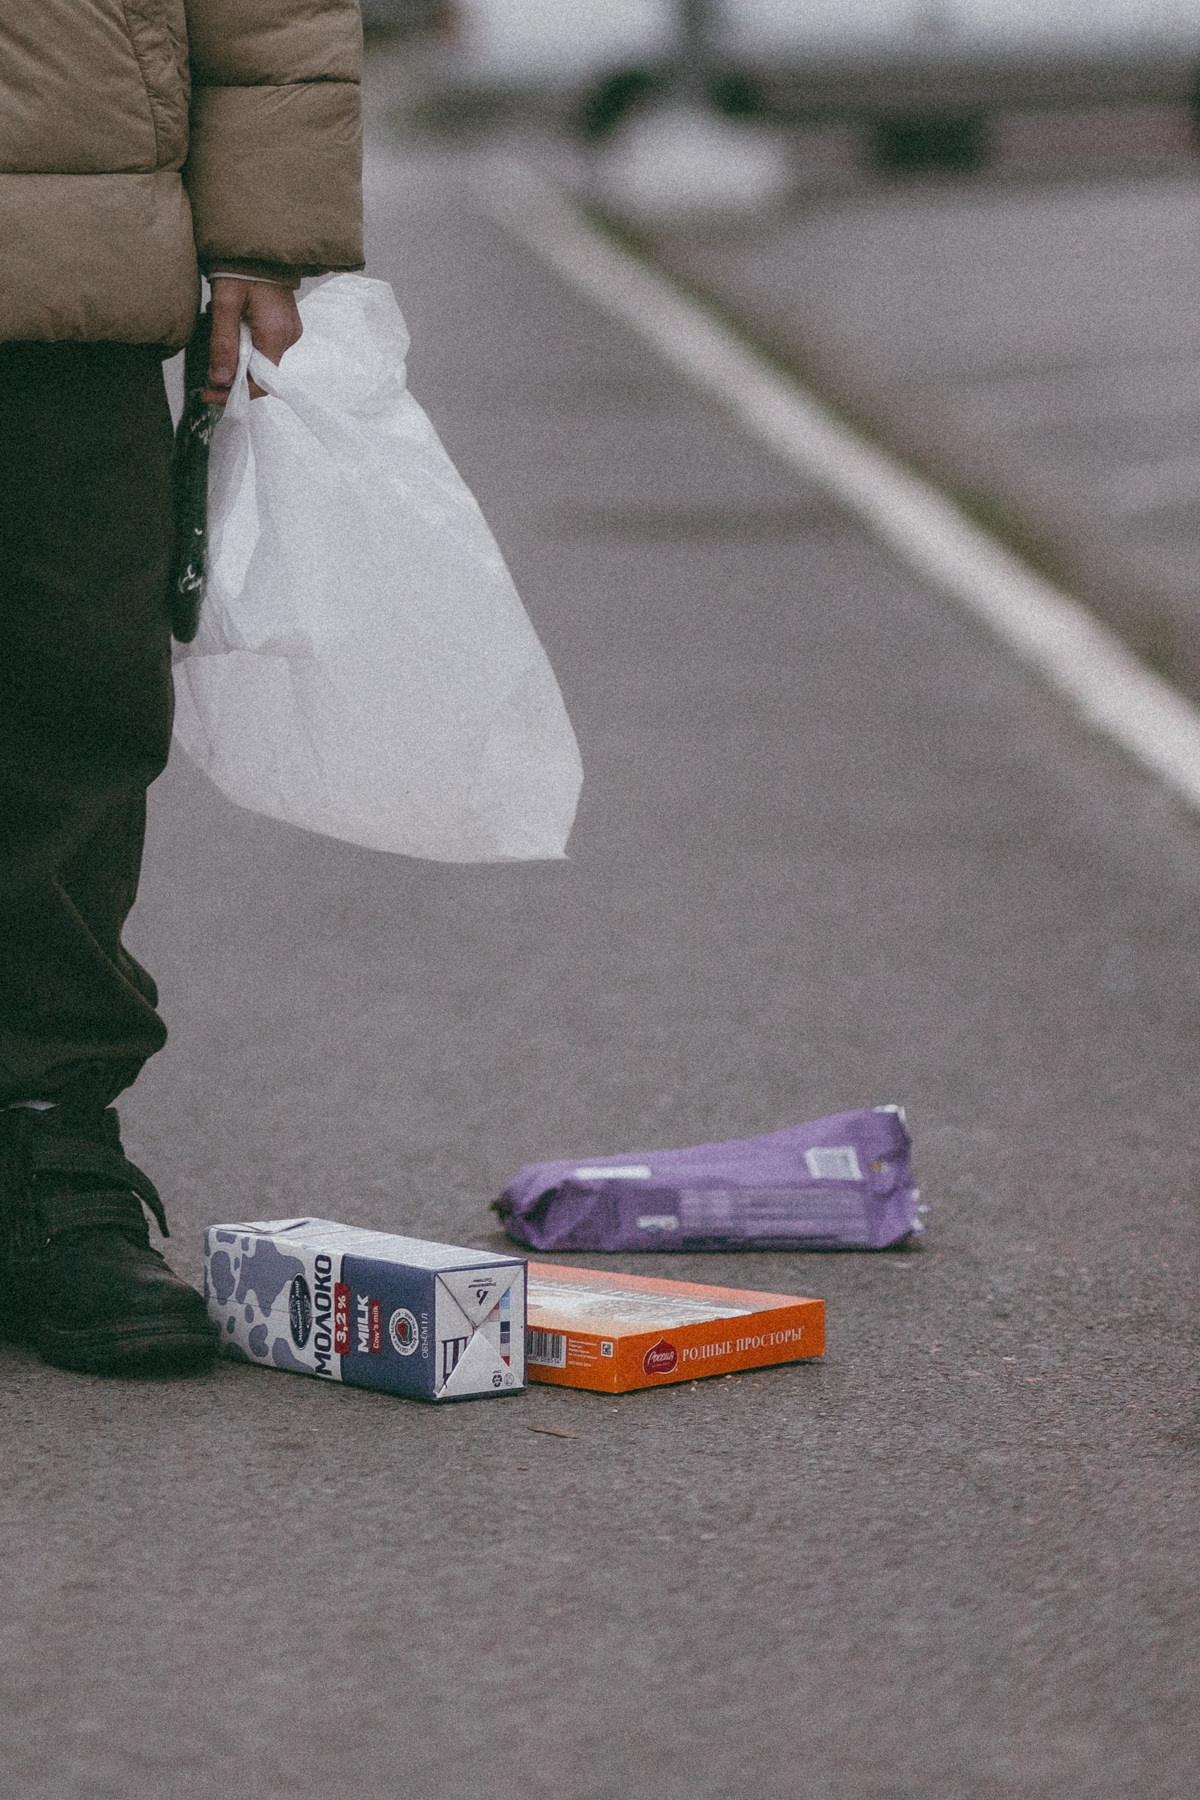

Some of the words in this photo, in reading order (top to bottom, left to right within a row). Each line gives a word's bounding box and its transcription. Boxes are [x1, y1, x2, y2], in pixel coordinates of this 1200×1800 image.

[314, 1254, 333, 1376] МОЛОКО
[336, 1312, 349, 1343] 3,2
[357, 1294, 370, 1353] MILK
[372, 1305, 380, 1323] milk
[372, 1324, 380, 1349] Cow's
[682, 1340, 733, 1362] РОДНЫЕ
[736, 1327, 802, 1352] ПРОСТОРЫ
[647, 1350, 675, 1366] Россия
